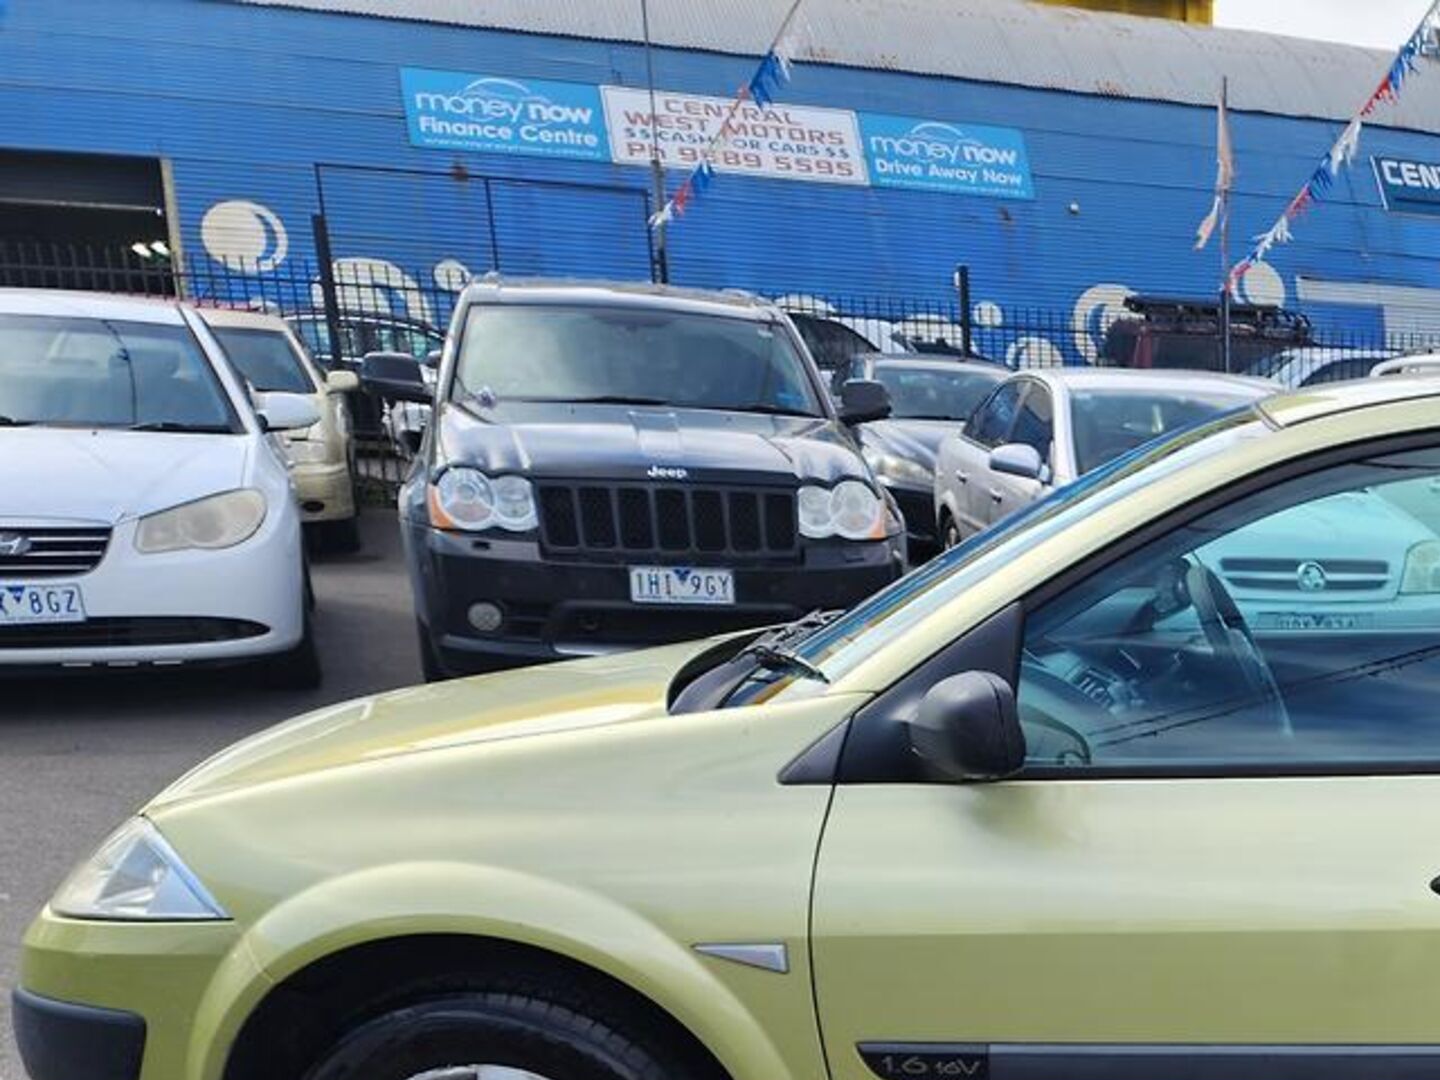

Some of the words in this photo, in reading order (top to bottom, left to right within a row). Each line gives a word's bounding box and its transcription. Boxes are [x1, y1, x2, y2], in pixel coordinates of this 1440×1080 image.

[415, 92, 524, 123] money
[527, 102, 592, 125] now
[664, 98, 802, 126] CENTRAL
[418, 116, 513, 140] Finance
[519, 125, 598, 147] Centre
[624, 110, 710, 132] WEST
[720, 120, 845, 146] MOTORS
[870, 136, 960, 163] money
[962, 144, 1017, 166] now
[775, 155, 854, 177] 5595
[875, 159, 922, 176] Drive
[928, 163, 978, 184] Away
[983, 169, 1023, 188] Now
[647, 465, 688, 480] Jeep
[882, 1056, 928, 1075] 1.6
[935, 1058, 981, 1076] 16V
